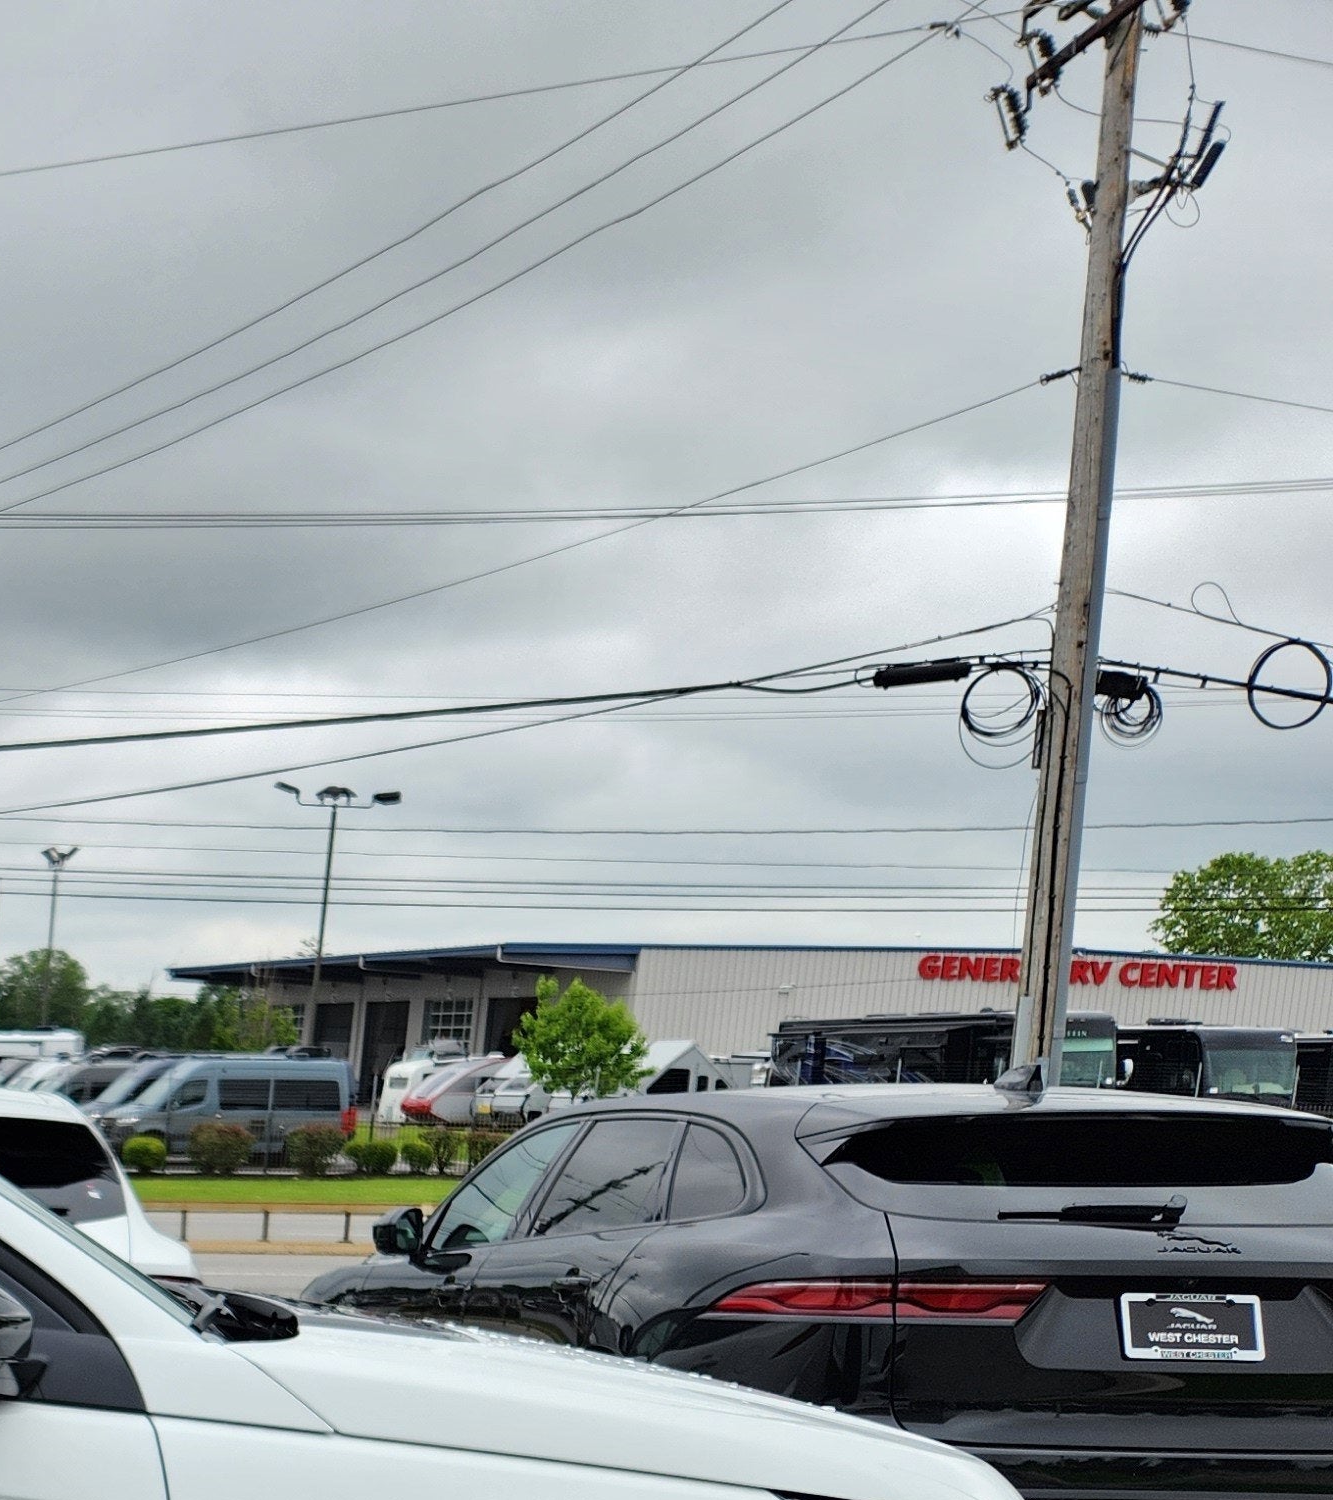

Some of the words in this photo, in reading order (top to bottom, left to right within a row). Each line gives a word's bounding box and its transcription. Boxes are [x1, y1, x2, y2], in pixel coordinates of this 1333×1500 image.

[918, 955, 1021, 983] GENER
[1069, 961, 1113, 986] RV
[1119, 961, 1238, 991] CENTER
[1157, 1246, 1242, 1255] JAGUAR
[1148, 1332, 1182, 1342] WEST
[1184, 1333, 1239, 1344] CHESTER
[1162, 1350, 1187, 1359] WEST
[1189, 1350, 1233, 1360] CHESTER
